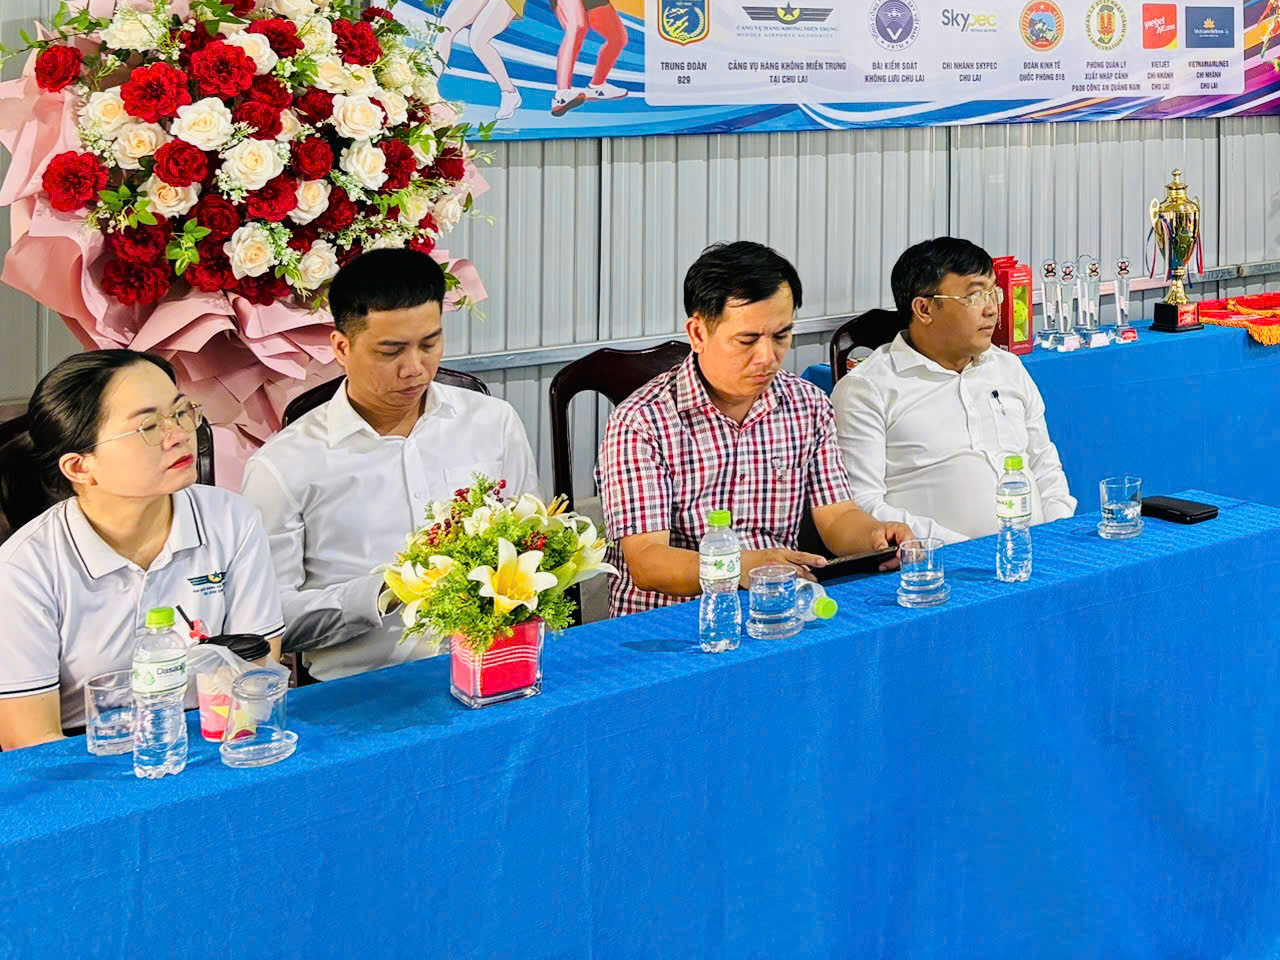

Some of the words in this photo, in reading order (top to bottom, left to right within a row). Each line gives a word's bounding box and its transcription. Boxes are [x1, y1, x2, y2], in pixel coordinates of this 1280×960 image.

[941, 8, 997, 32] Skypec
[660, 61, 685, 71] TRUNG
[687, 60, 707, 71] ĐOÀN
[749, 62, 759, 72] VỤ
[781, 60, 805, 71] KHÔNG
[825, 61, 847, 70] TRUNG
[942, 62, 952, 70] CHI
[976, 61, 998, 70] SKYPEC
[677, 75, 691, 85] 929
[769, 75, 780, 86] TẠI
[782, 75, 796, 84] CHU
[797, 75, 808, 84] LAI
[864, 74, 886, 83] KHÔNG
[901, 74, 913, 83] CHU
[915, 74, 925, 82] LAI
[959, 74, 971, 82] CHU
[972, 74, 982, 82] LAI
[1129, 83, 1141, 91] NAM
[1200, 82, 1211, 90] CHU
[1211, 82, 1219, 90] LAI
